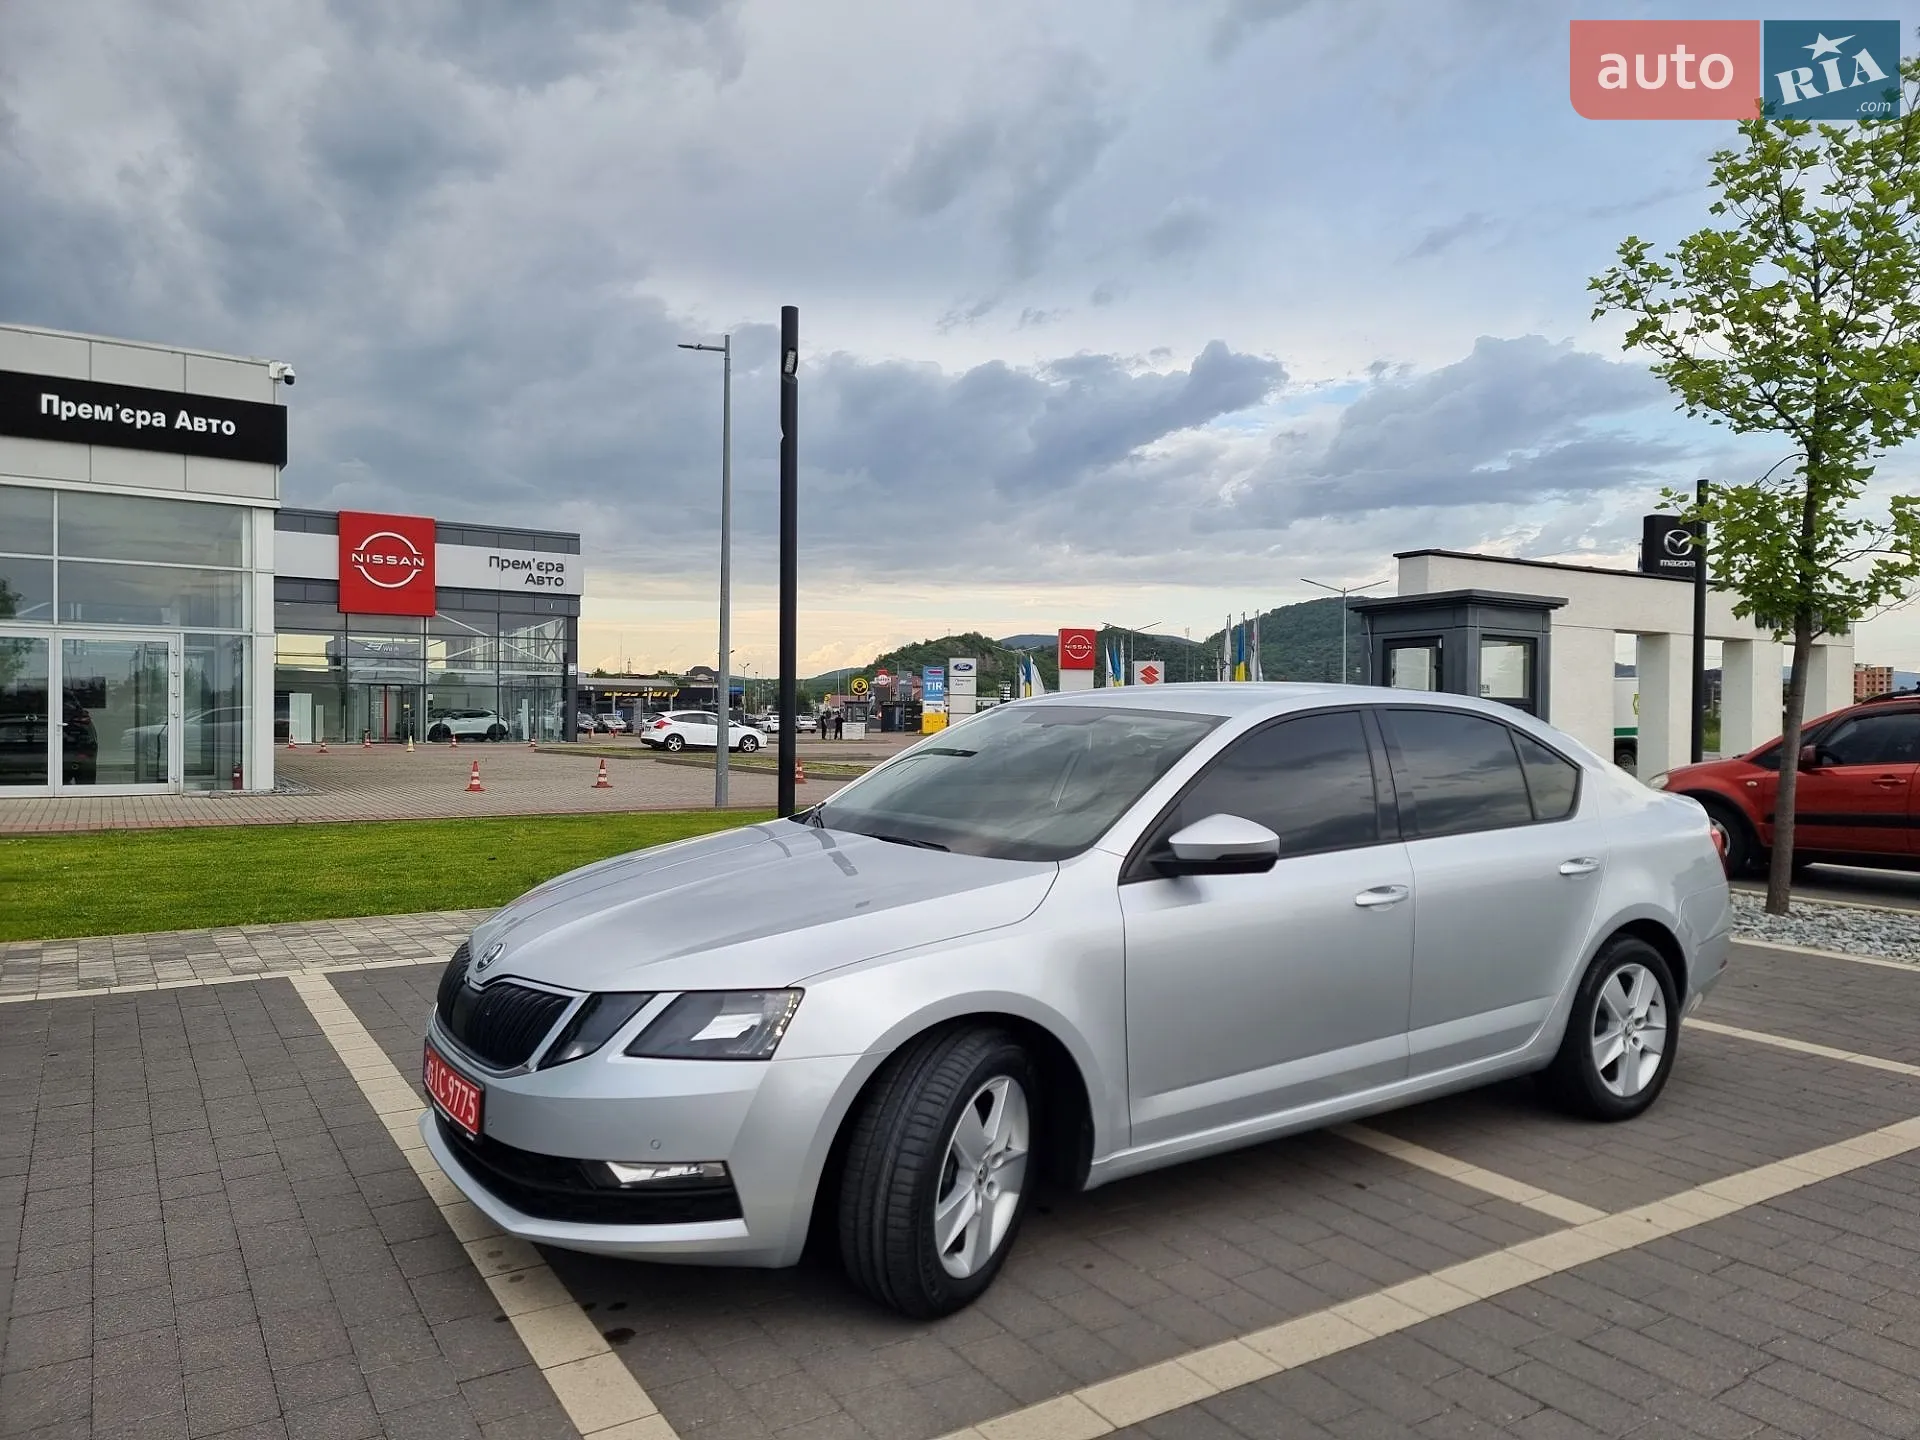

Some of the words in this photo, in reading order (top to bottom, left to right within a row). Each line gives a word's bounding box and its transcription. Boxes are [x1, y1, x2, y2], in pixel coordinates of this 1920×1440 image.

[174, 410, 236, 436] Авто
[351, 552, 425, 566] NISSAN
[524, 573, 564, 587] Авто
[926, 682, 942, 690] TIR
